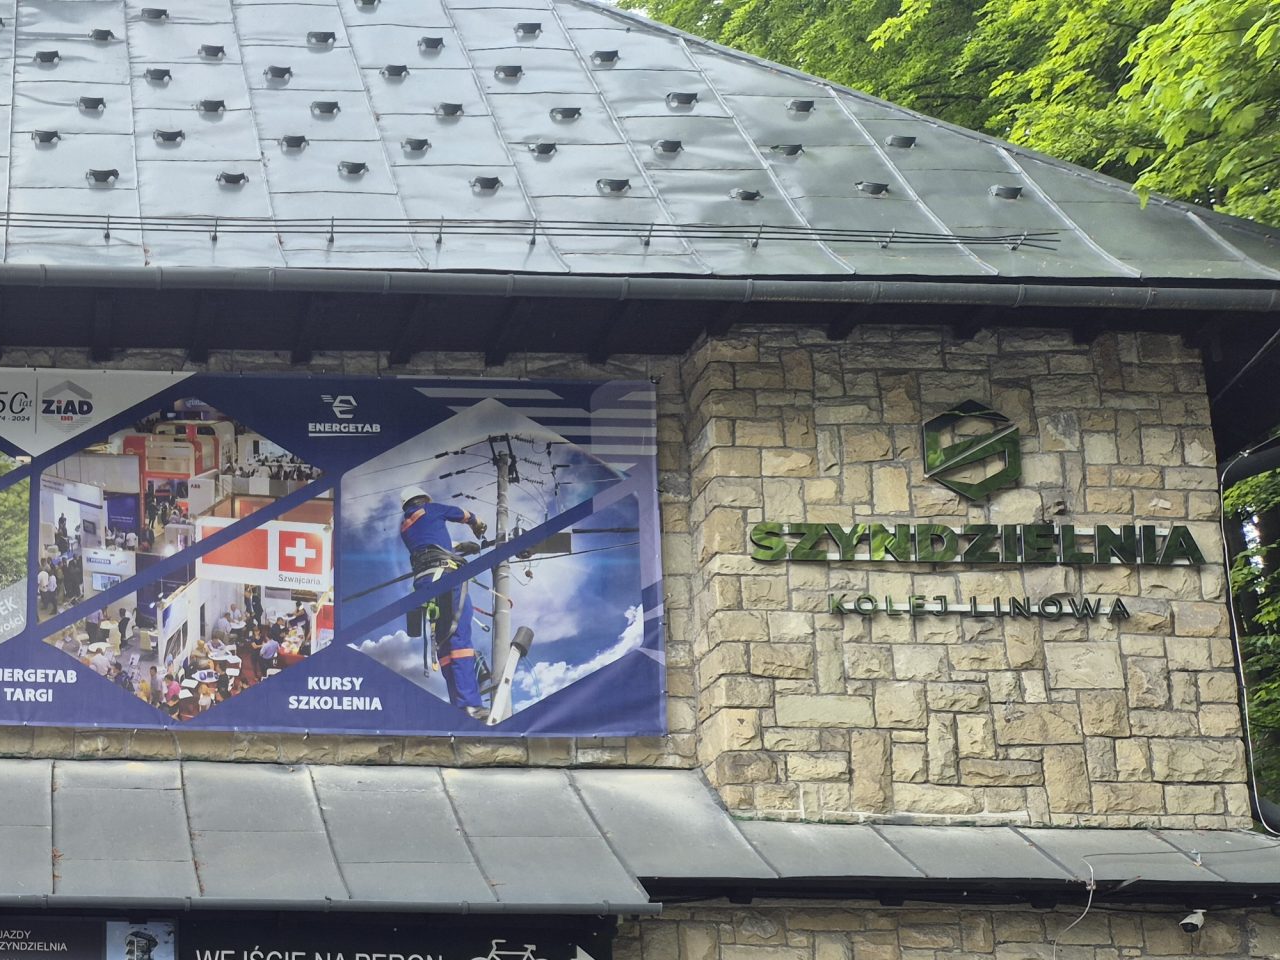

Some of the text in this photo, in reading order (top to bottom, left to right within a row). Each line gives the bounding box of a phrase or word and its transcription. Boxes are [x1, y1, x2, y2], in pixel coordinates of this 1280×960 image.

[308, 422, 381, 433] ENERGETAB
[749, 522, 1207, 566] SZYNDZIELNIA
[278, 573, 321, 585] Szwajcaria
[828, 593, 1131, 620] KOLEJ LINOWA
[307, 676, 363, 690] KURSY
[4, 688, 53, 702] TARGI
[288, 696, 383, 710] SZKOLENIA
